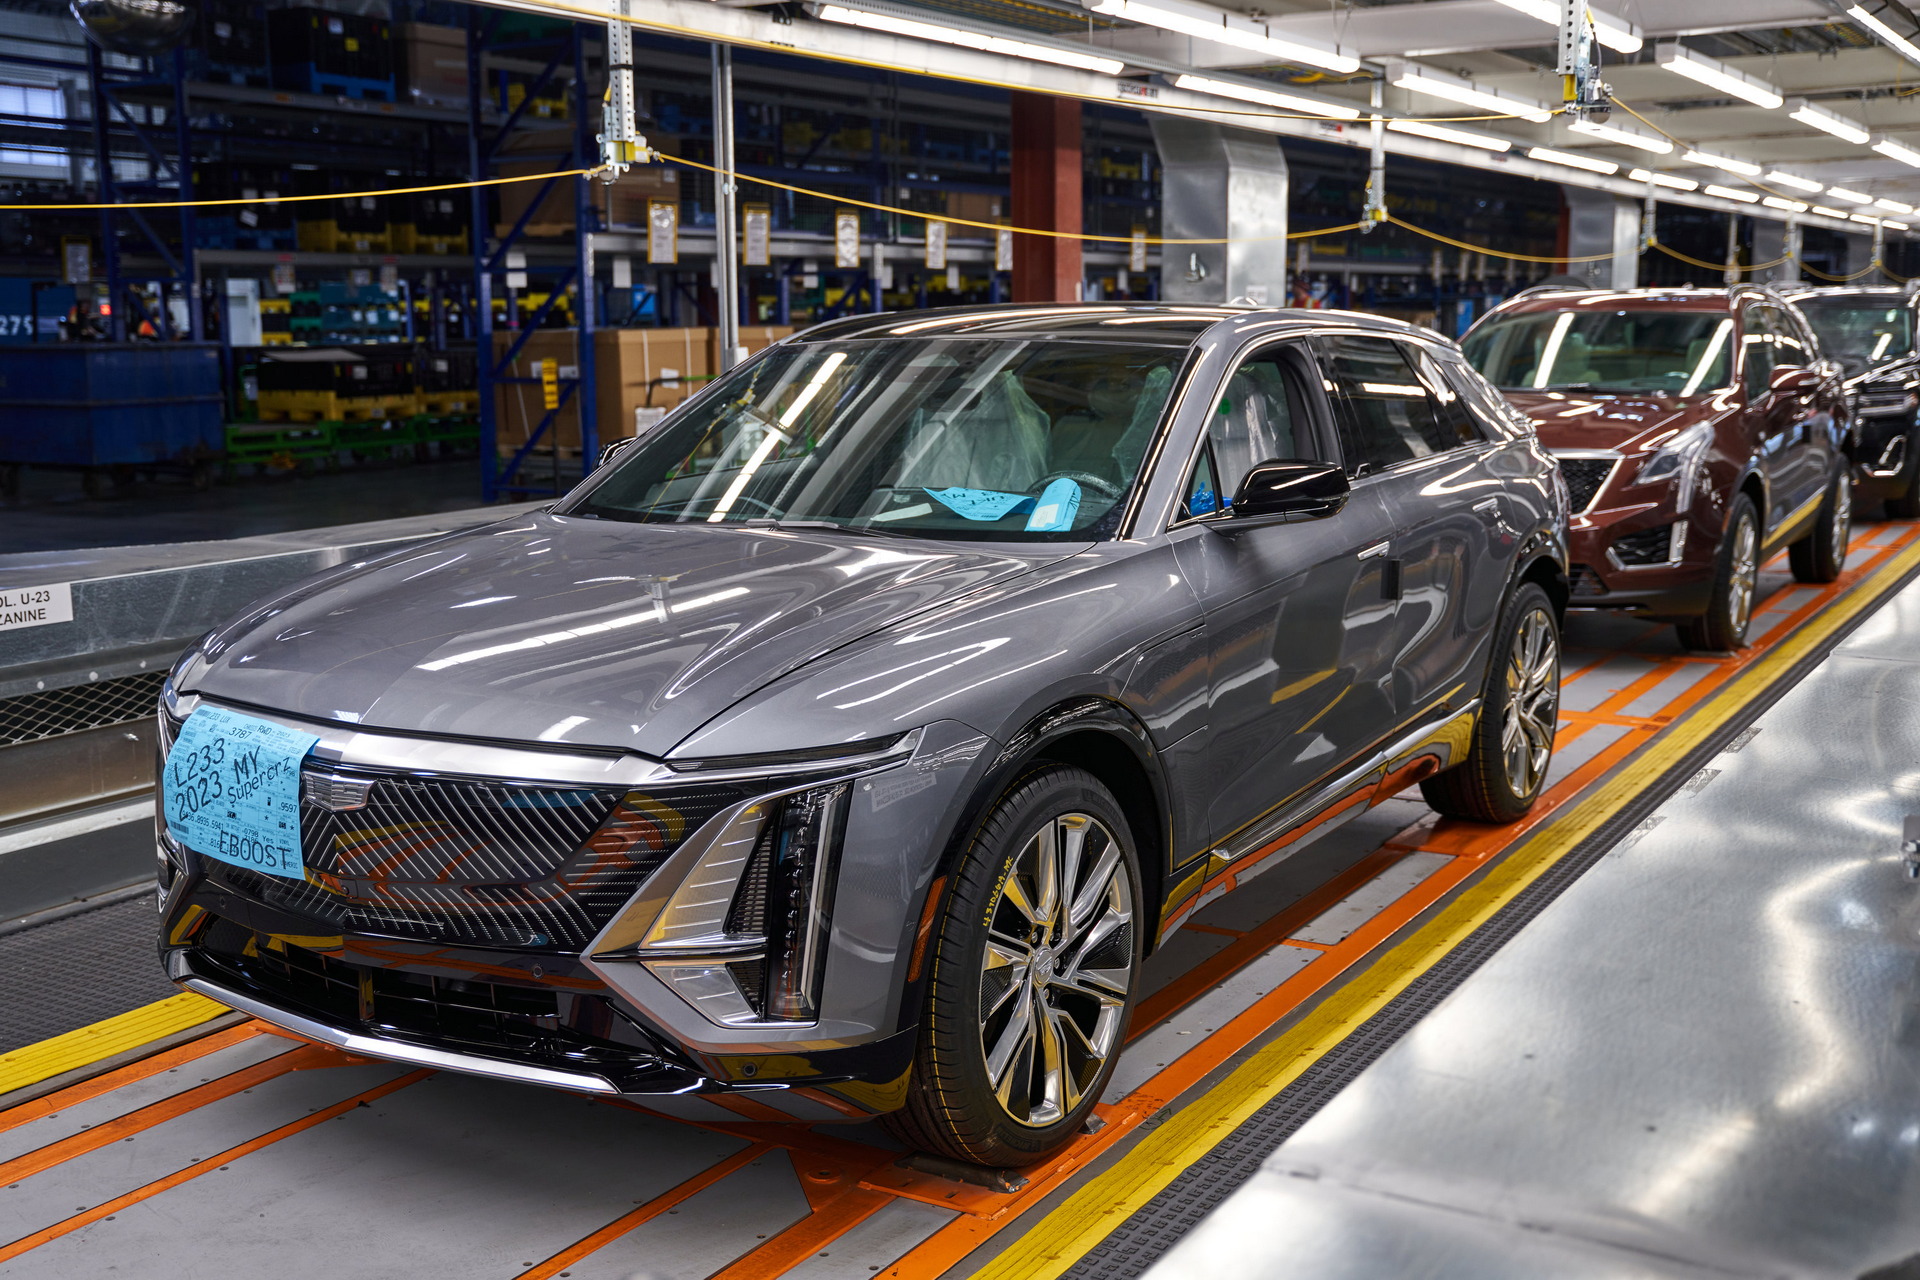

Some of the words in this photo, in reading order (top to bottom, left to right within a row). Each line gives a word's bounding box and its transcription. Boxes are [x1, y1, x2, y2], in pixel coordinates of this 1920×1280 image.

[21, 590, 50, 605] U-23
[229, 727, 252, 739] 3787
[174, 738, 225, 788] L233
[175, 771, 222, 821] 2023
[233, 745, 261, 785] MY
[219, 830, 291, 869] EBOOST
[262, 836, 274, 845] Yes
